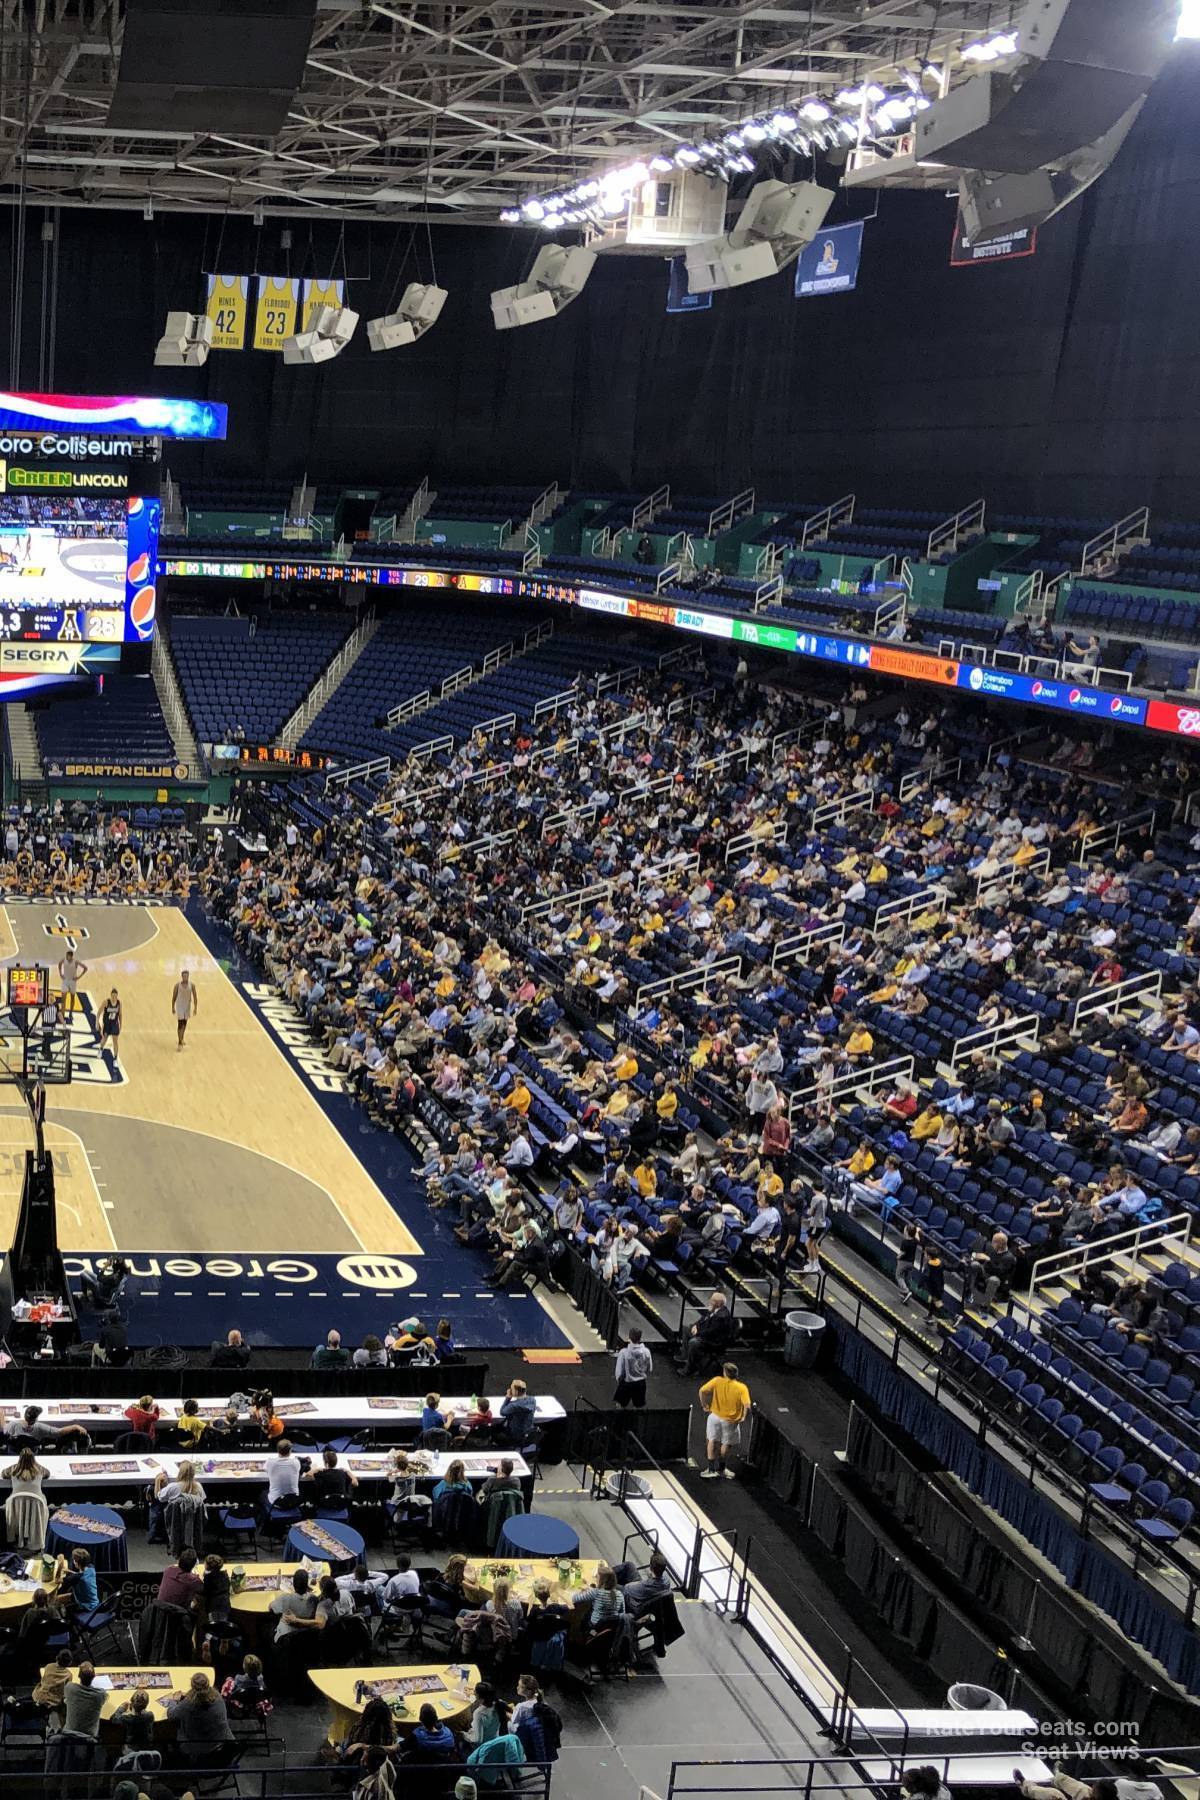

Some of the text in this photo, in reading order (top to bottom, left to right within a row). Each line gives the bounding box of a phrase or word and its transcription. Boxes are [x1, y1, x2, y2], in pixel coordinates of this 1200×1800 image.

[218, 297, 236, 306] HINES
[215, 310, 236, 333] 42
[265, 311, 286, 335] 23
[40, 434, 132, 456] Coliseum
[8, 468, 128, 488] GREEN LINCOLN
[186, 564, 244, 575] DO THE DEW
[414, 574, 430, 587] 29
[479, 579, 492, 593] 26
[682, 613, 704, 627] BRADY
[88, 616, 116, 638] 26
[3, 649, 69, 662] SEGRA
[983, 671, 1014, 687] Greensboro
[982, 681, 1006, 693] Coliseum
[1041, 686, 1058, 699] pepsi
[1080, 694, 1097, 707] pepsi
[1121, 703, 1139, 716] pepsi
[65, 765, 173, 777] SPARTAN CLUB
[4, 894, 165, 907] Coliseum
[12, 970, 36, 982] 33.3
